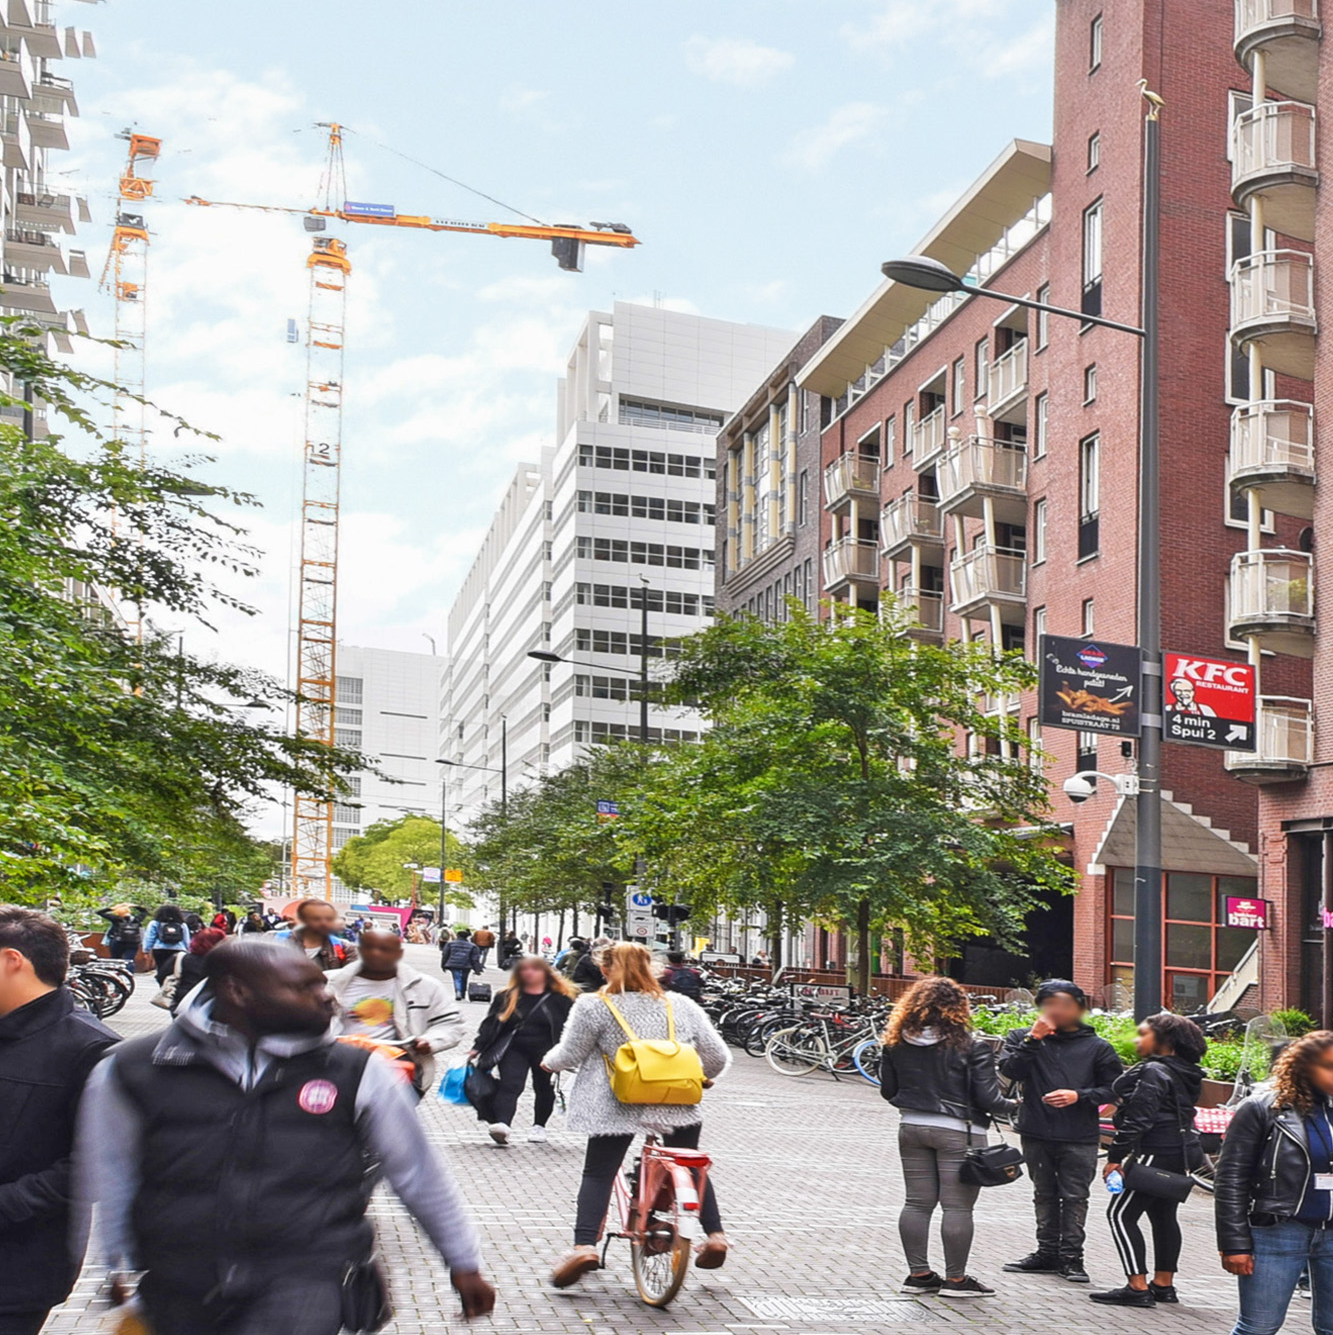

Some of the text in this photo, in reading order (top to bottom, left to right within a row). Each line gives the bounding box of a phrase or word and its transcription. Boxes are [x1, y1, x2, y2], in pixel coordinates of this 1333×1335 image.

[1055, 664, 1077, 675] Echte
[1172, 658, 1248, 687] KFC
[1195, 680, 1250, 694] RESTAURANT
[1061, 717, 1109, 729] SPUISTRAAT
[1172, 713, 1210, 728] 4 min
[1171, 724, 1216, 740] Spui 2
[1228, 913, 1265, 928] bart
